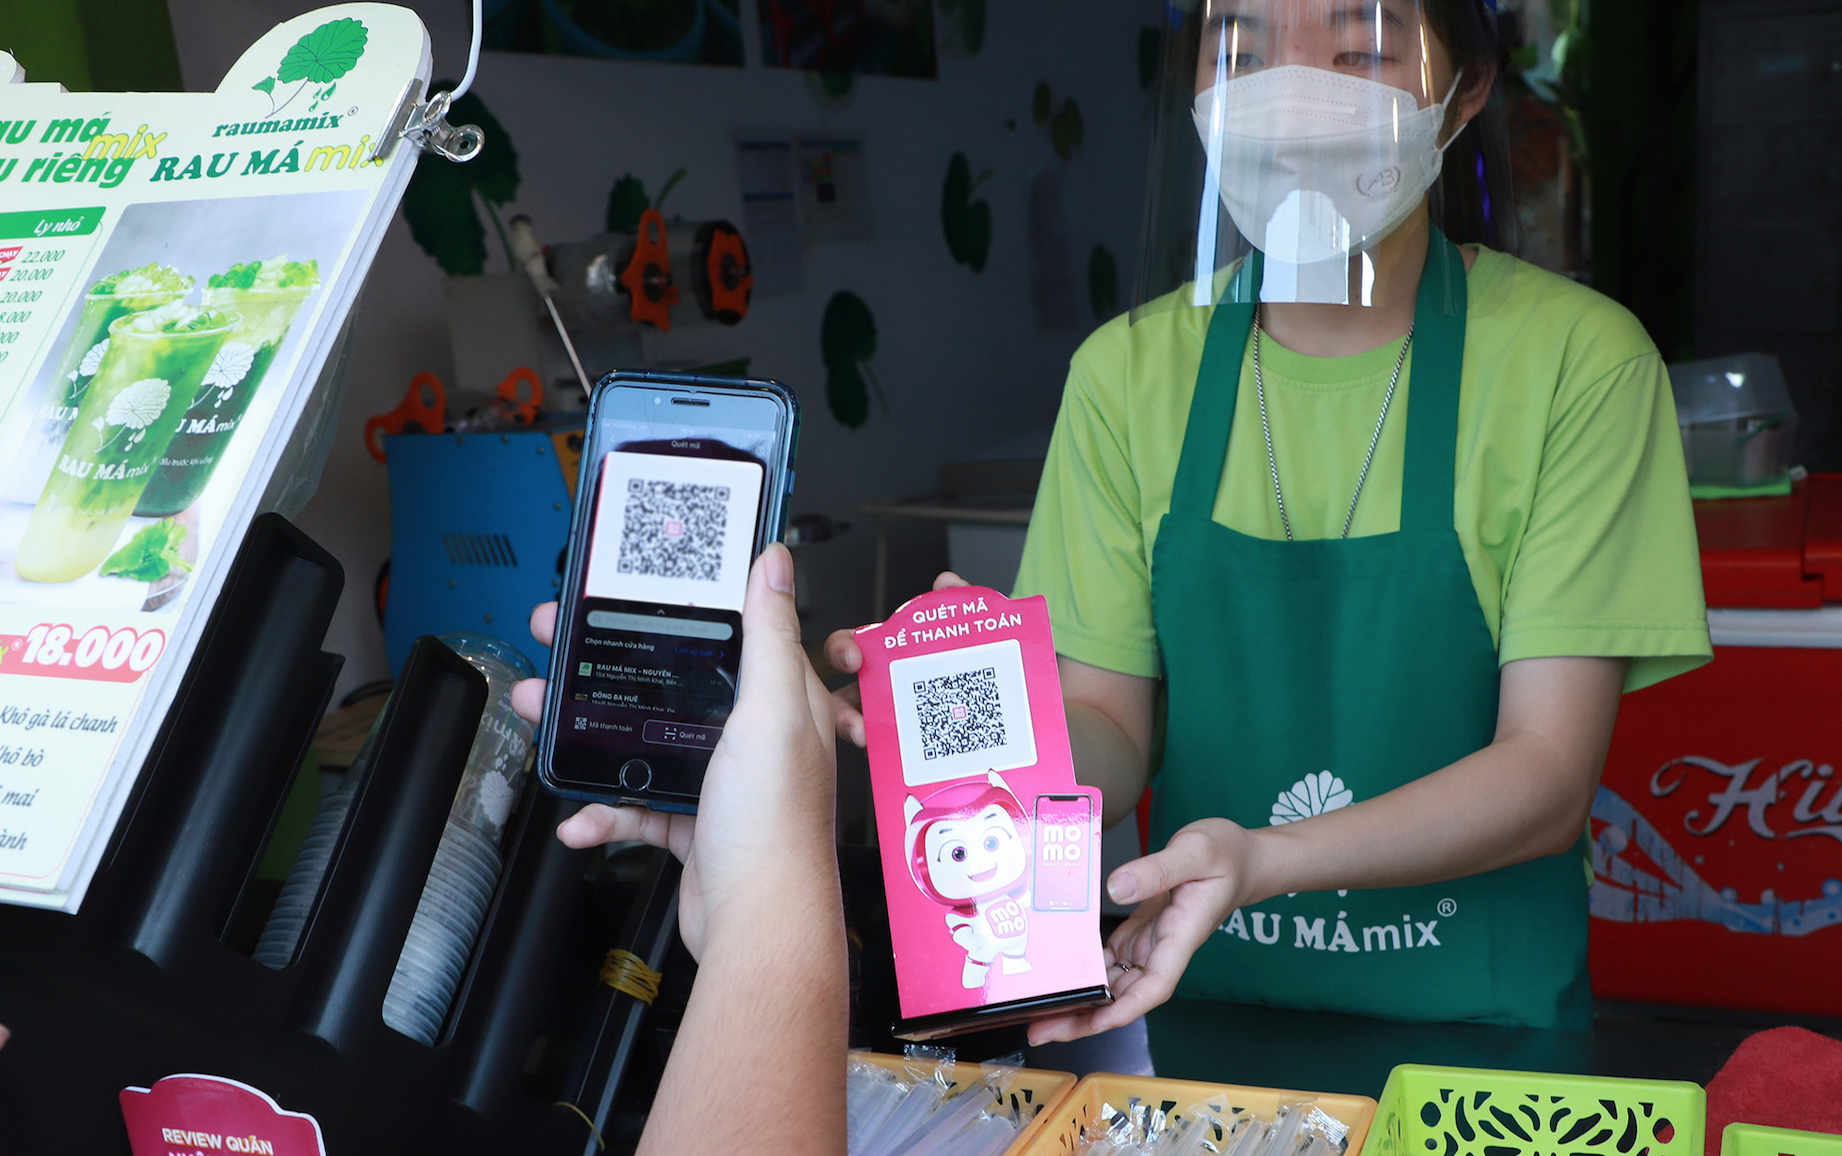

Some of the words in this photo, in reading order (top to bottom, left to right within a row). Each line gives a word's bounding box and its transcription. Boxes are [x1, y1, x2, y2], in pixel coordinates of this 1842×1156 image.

[39, 111, 112, 143] má
[82, 124, 168, 160] mix
[212, 111, 344, 137] raumamix
[21, 151, 135, 189] riêng
[149, 152, 239, 182] RAU
[34, 219, 53, 236] Ly
[21, 250, 65, 263] 22.000
[9, 268, 53, 281] 20.000
[671, 440, 688, 449] Quét
[58, 455, 94, 478] RAU
[912, 604, 958, 624] QUÉT
[962, 597, 989, 616] MÃ
[884, 628, 908, 649] ĐỂ
[911, 622, 970, 644] THANH
[974, 613, 1022, 633] TOÁN
[22, 624, 165, 672] 18.000
[585, 637, 601, 646] Chọn
[603, 638, 624, 647] nhanh
[637, 642, 655, 651] hàng
[596, 663, 611, 671] RAU
[0, 705, 30, 725] Khô
[25, 709, 50, 730] gà
[50, 711, 72, 728] lá
[69, 713, 118, 733] chanh
[589, 721, 599, 729] Mã
[600, 722, 617, 731] thanh
[619, 724, 633, 732] toán
[679, 731, 694, 740] Quét
[695, 733, 706, 741] mã
[0, 745, 22, 765] hô
[20, 748, 44, 767] bò
[1218, 908, 1281, 945] AU
[162, 1127, 222, 1150] REVIEW
